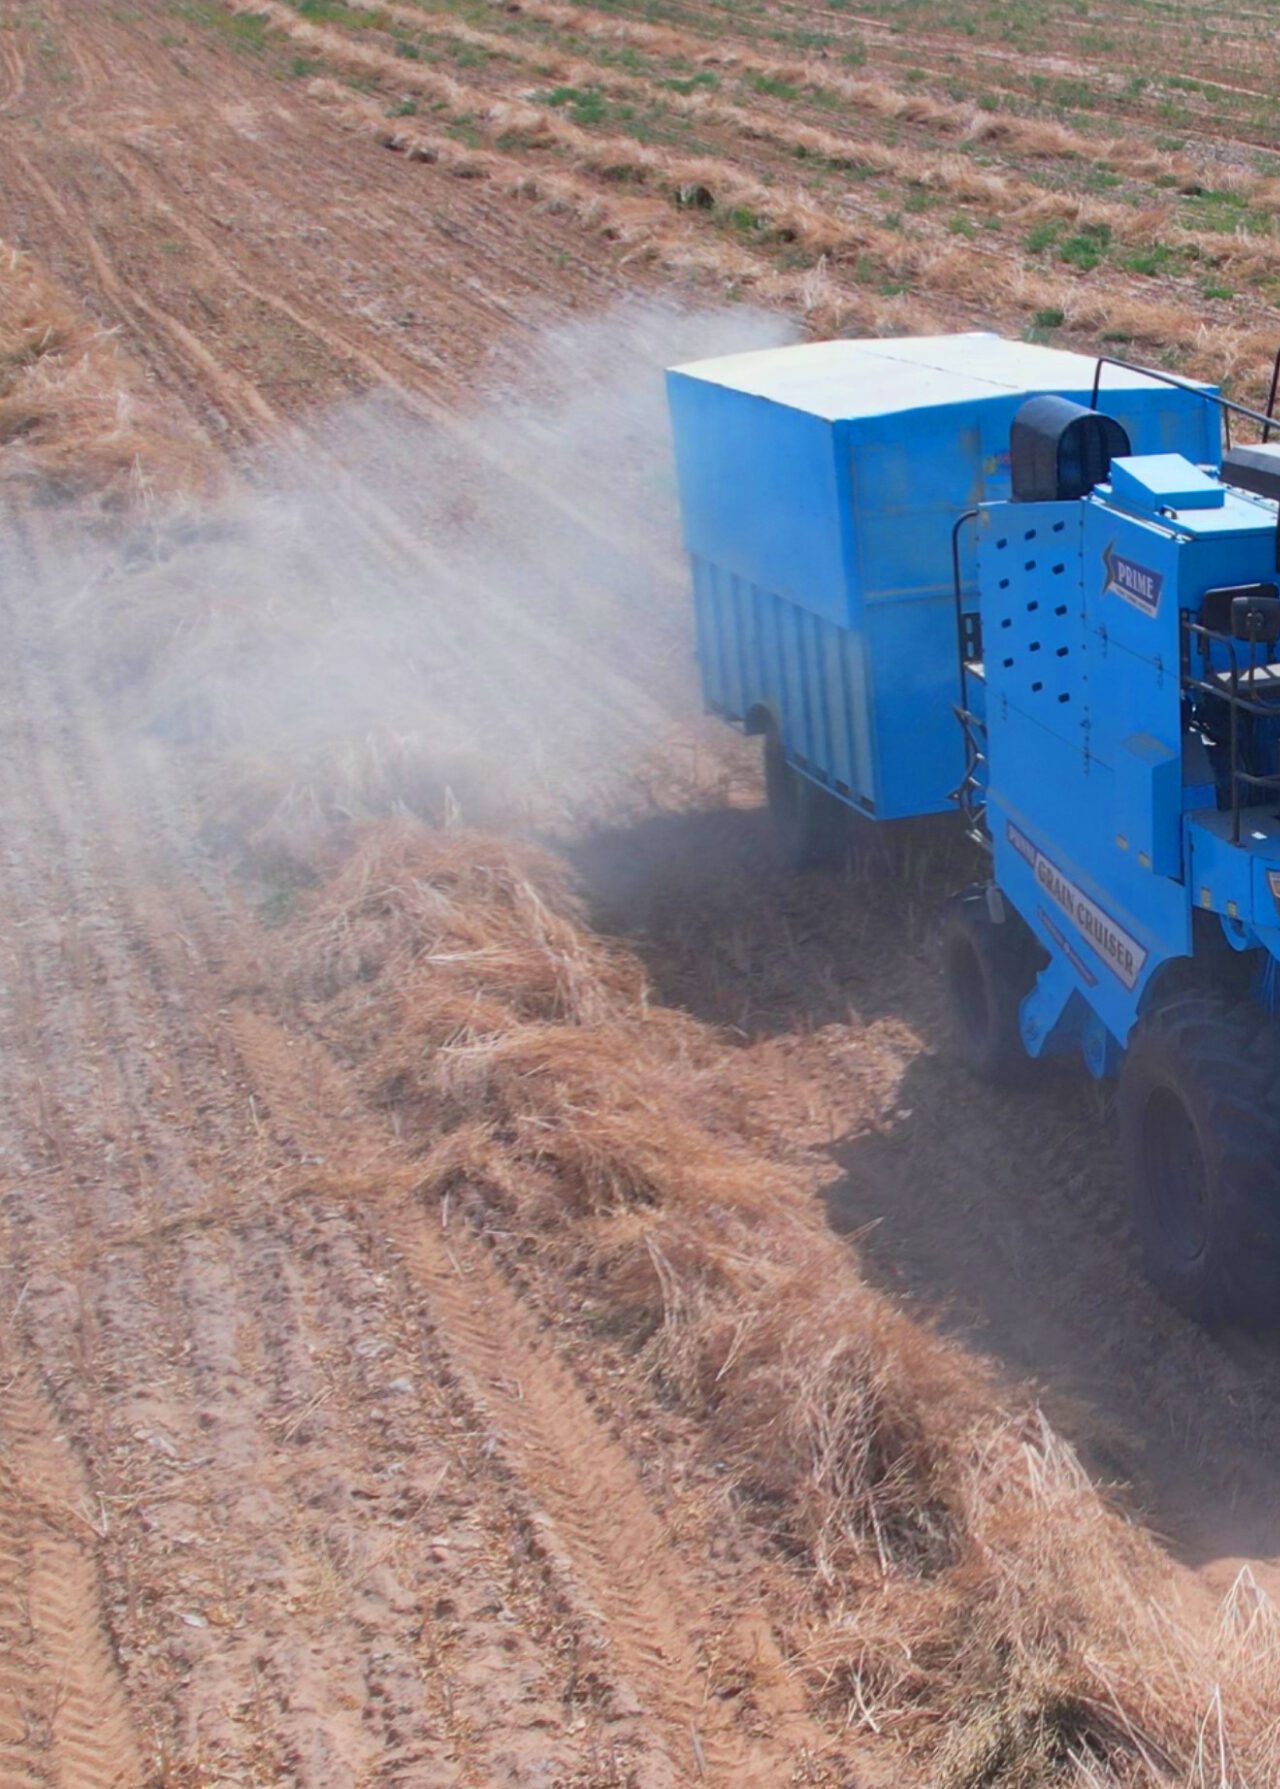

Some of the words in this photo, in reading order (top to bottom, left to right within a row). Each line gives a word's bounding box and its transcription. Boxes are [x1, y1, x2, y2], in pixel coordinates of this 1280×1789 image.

[1117, 560, 1155, 600] PRIME
[1037, 860, 1075, 915] GRAIN
[1077, 903, 1134, 976] CRUISER
